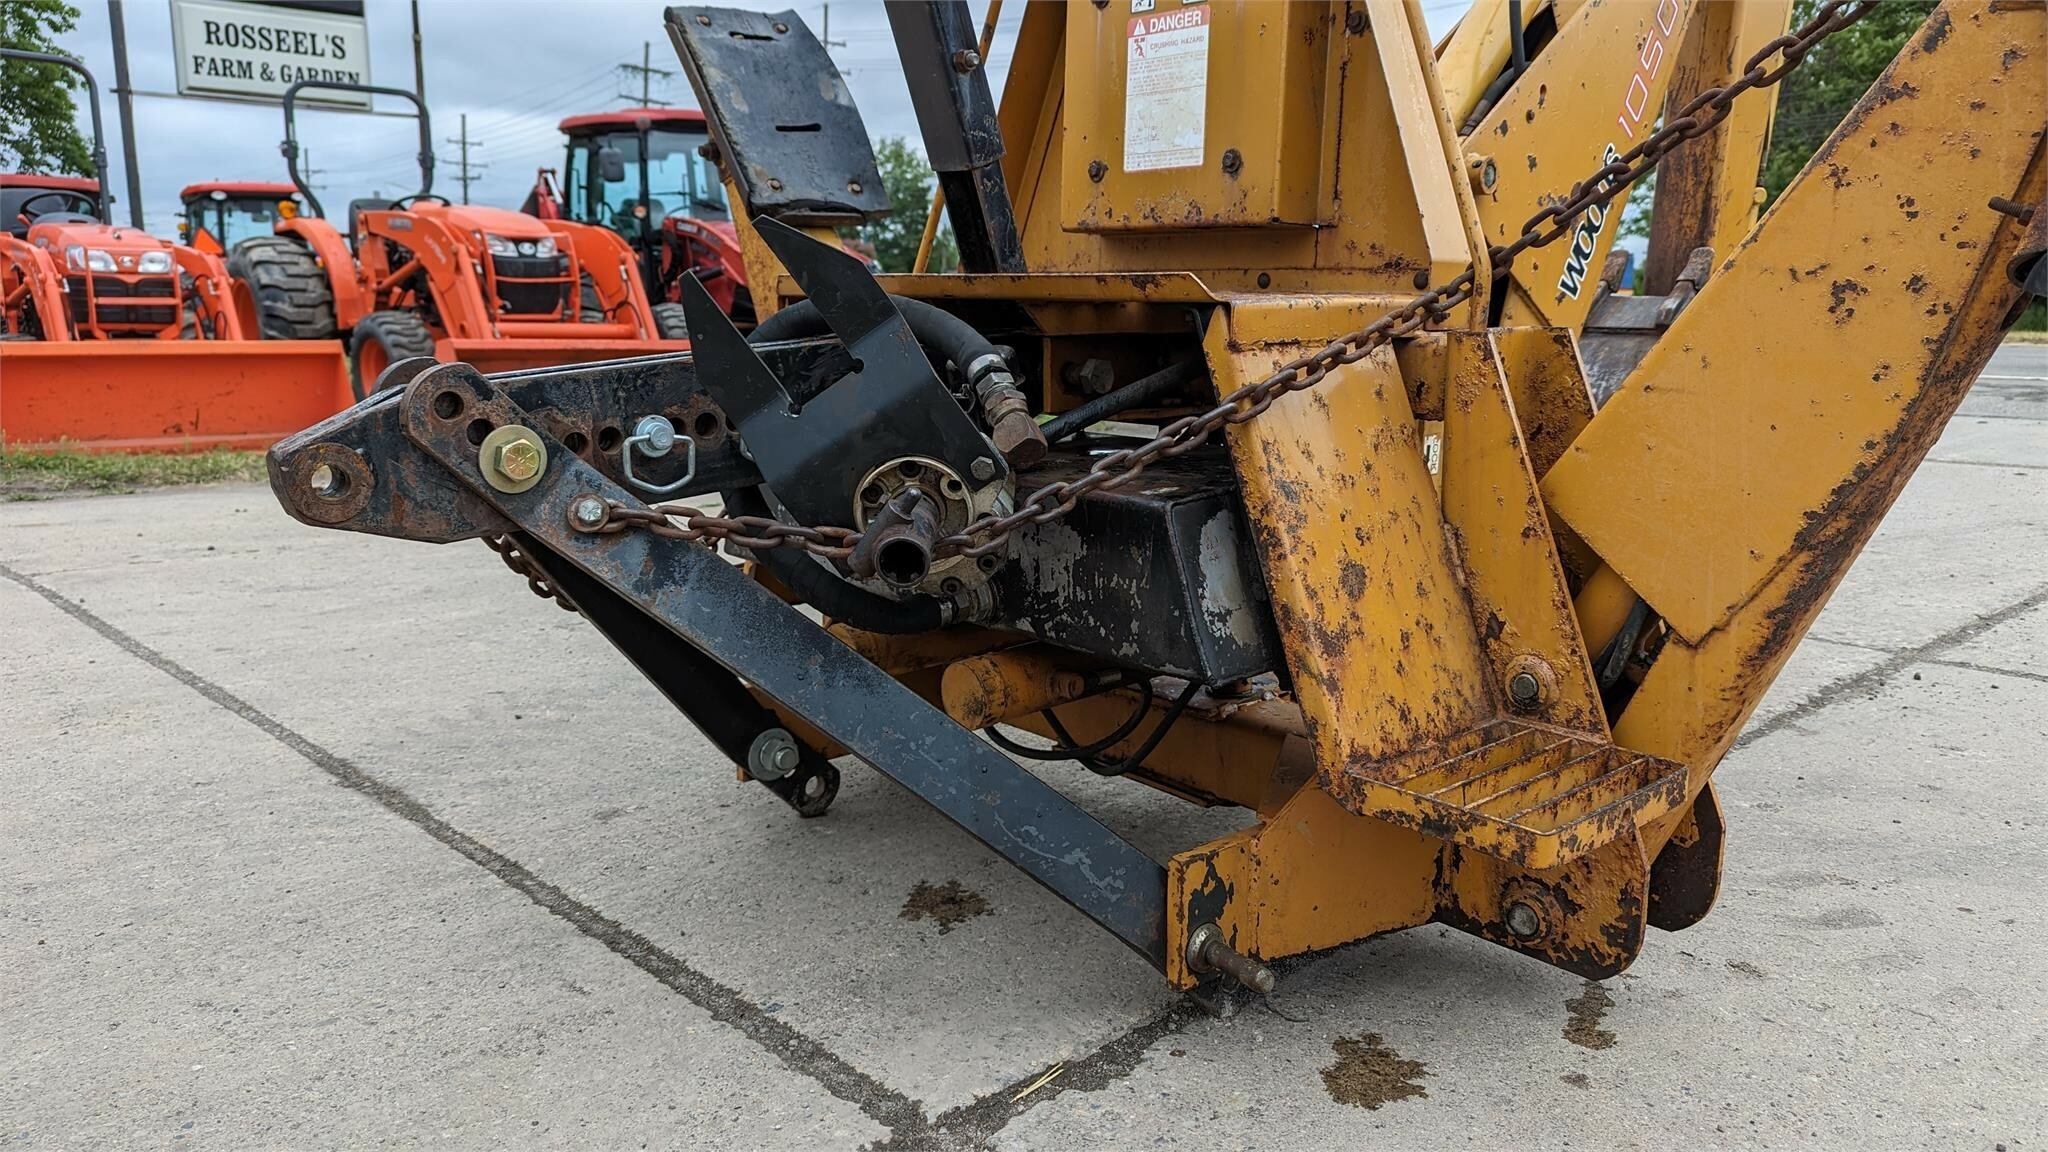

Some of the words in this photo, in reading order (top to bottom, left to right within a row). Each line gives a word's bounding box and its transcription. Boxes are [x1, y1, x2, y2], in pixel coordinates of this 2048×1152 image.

[1149, 10, 1202, 33] DANGER
[203, 20, 346, 60] ROSSEEL'S
[1180, 35, 1205, 46] HAZARD
[192, 54, 254, 80] FARM
[260, 62, 276, 82] &
[280, 63, 361, 85] GARDEN
[1617, 0, 1680, 140] 1050
